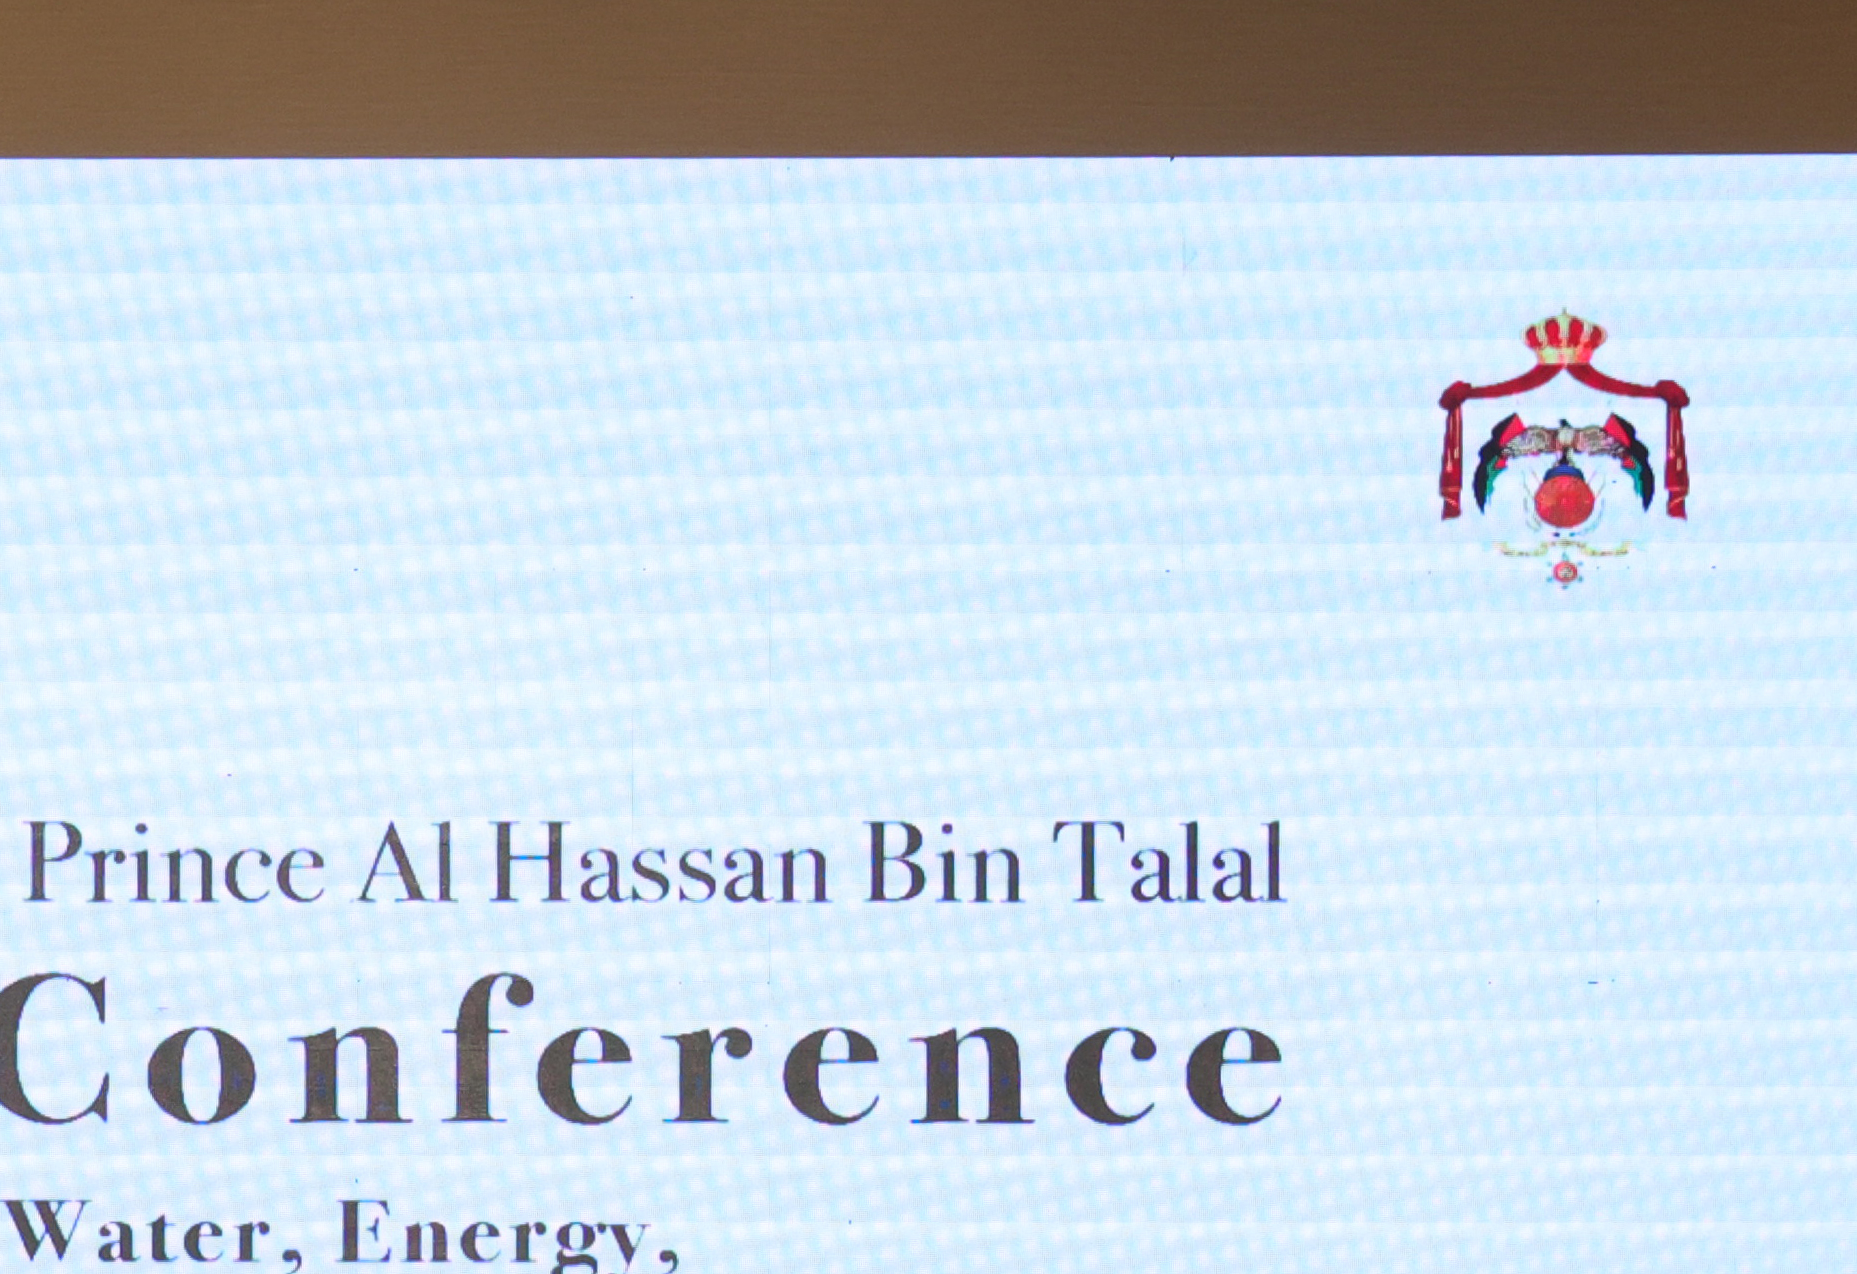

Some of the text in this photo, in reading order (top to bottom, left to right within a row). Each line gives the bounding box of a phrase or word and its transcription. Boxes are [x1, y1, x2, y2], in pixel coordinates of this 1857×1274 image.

[28, 820, 325, 904] Prince
[358, 820, 453, 903] Al
[494, 820, 829, 904] Hassan
[868, 820, 1021, 904] Bin
[1052, 819, 1283, 904] Talal
[4, 1198, 303, 1274] Water,
